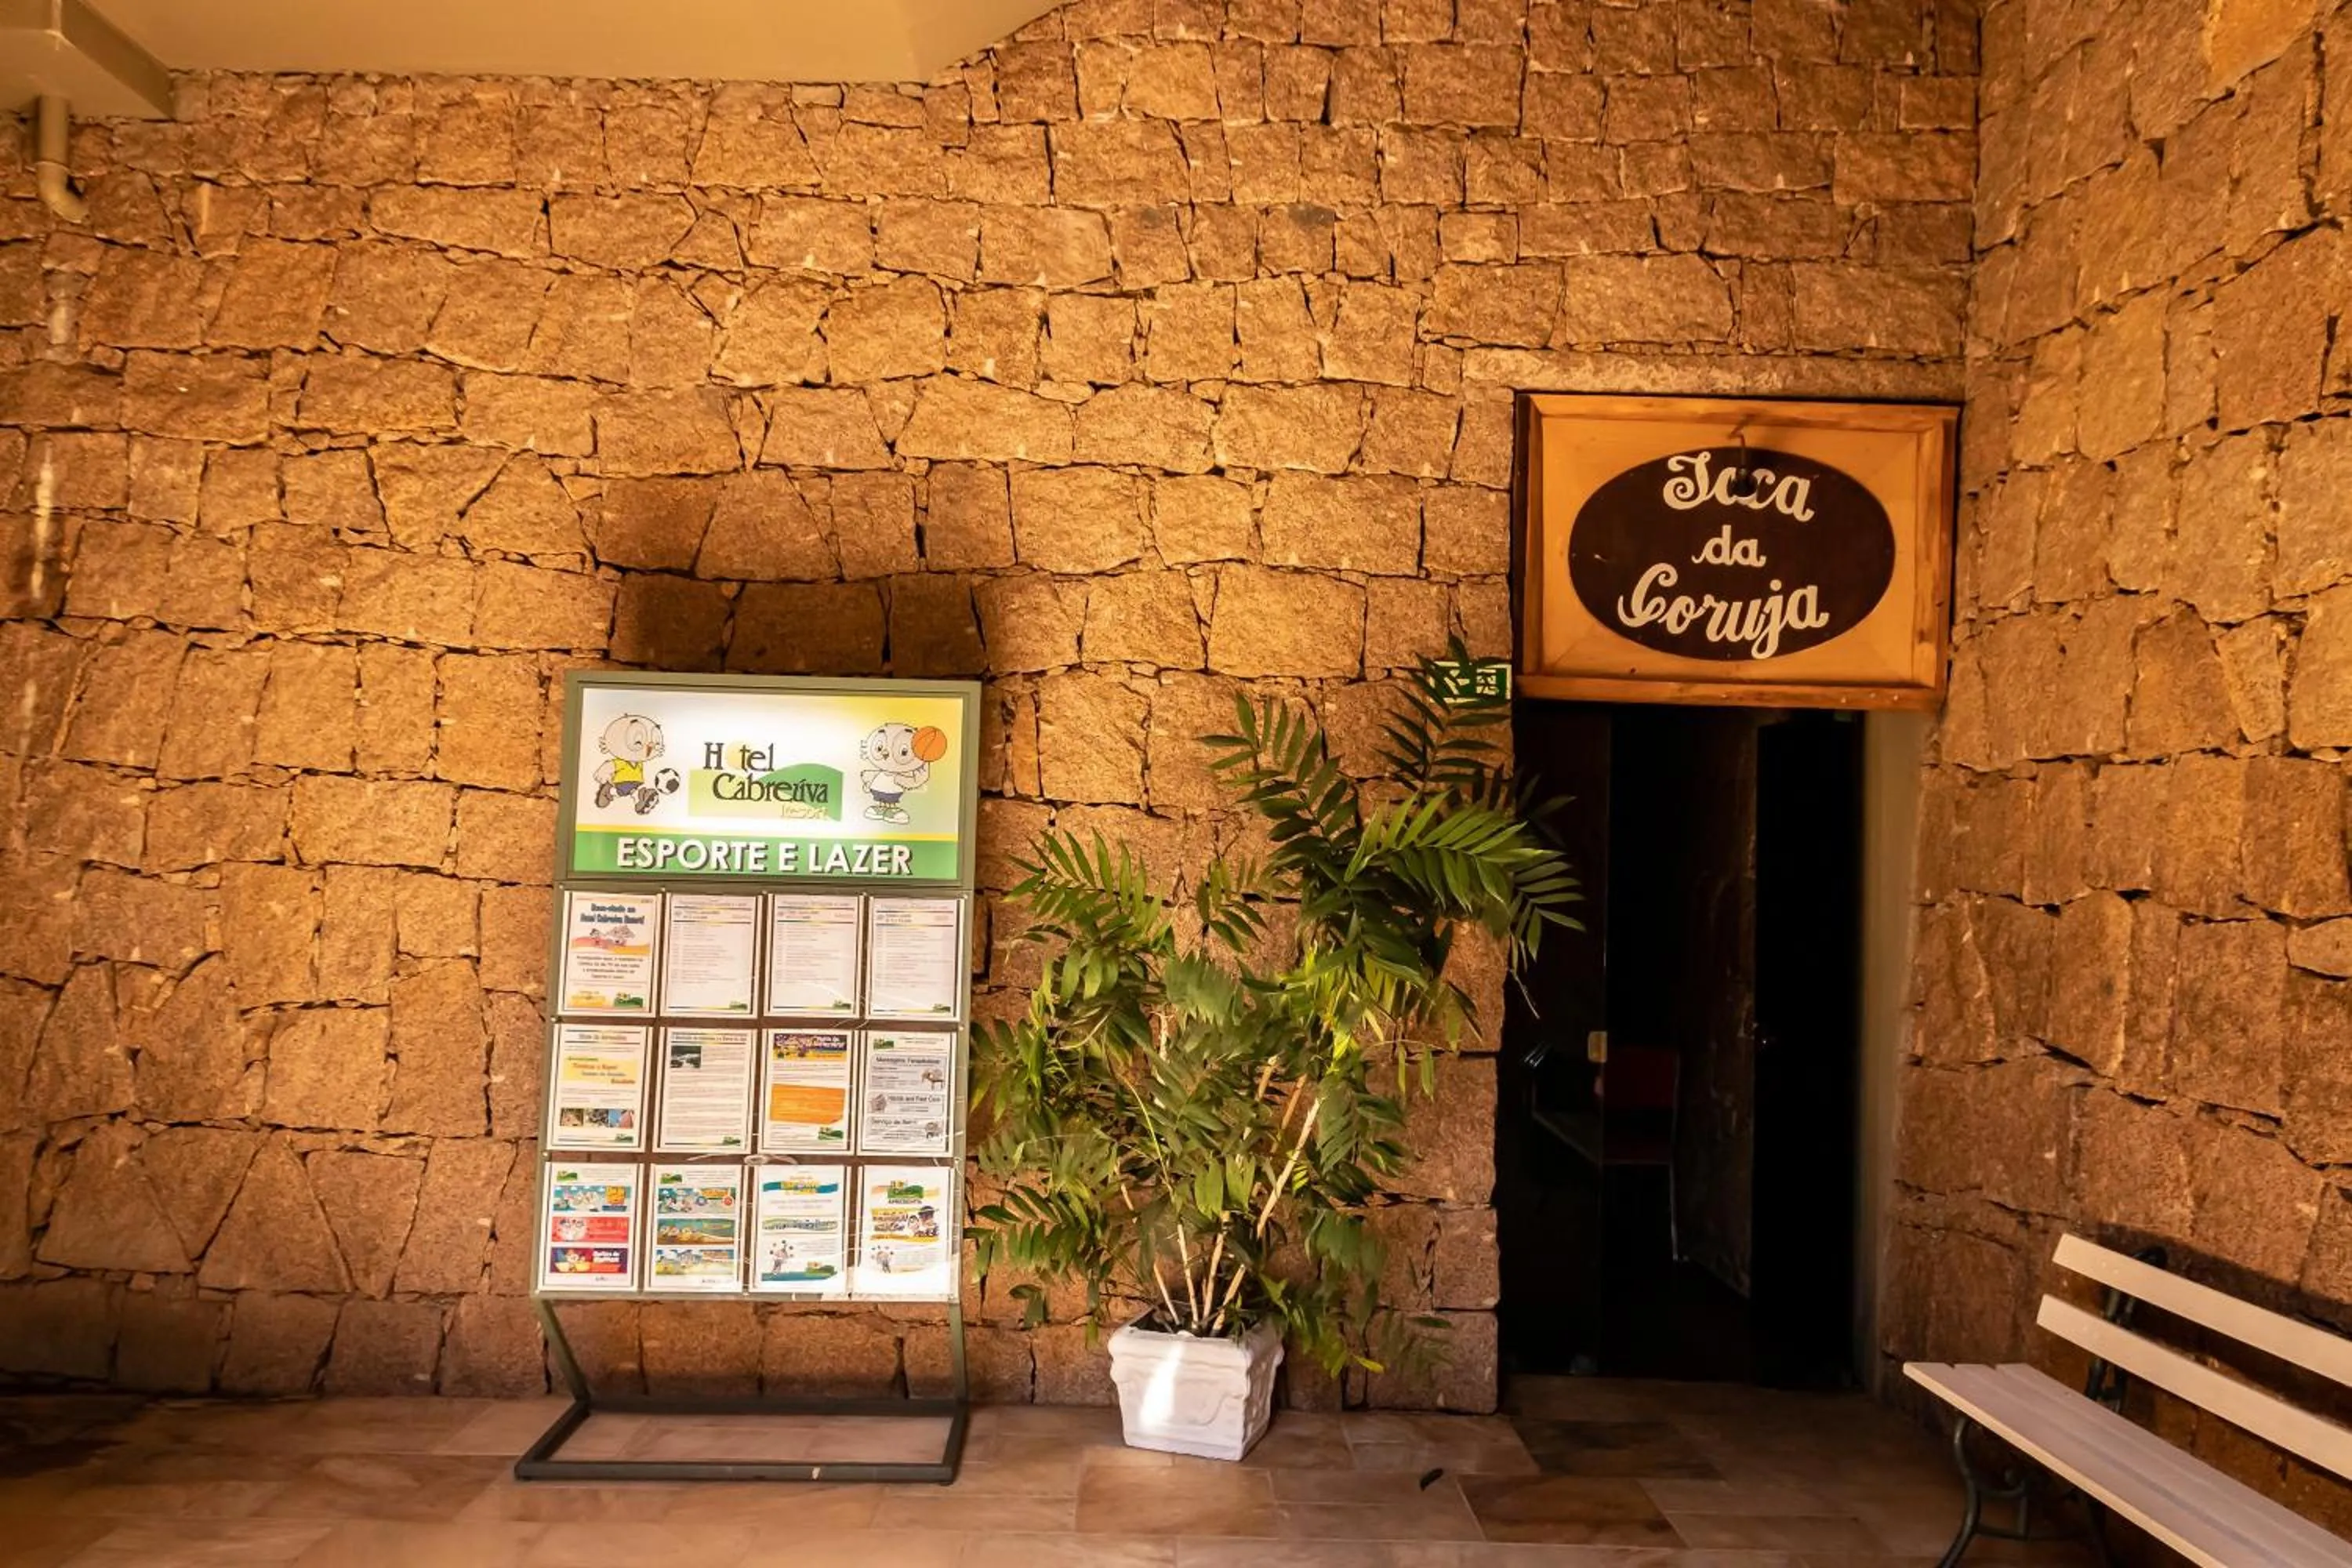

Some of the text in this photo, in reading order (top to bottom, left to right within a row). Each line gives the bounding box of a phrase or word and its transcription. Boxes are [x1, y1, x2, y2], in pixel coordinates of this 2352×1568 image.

[1692, 524, 1766, 568] da
[1617, 562, 1830, 660] Coruja
[713, 772, 829, 804] Cabreúva
[616, 837, 913, 875] ESPORTE E LAZER
